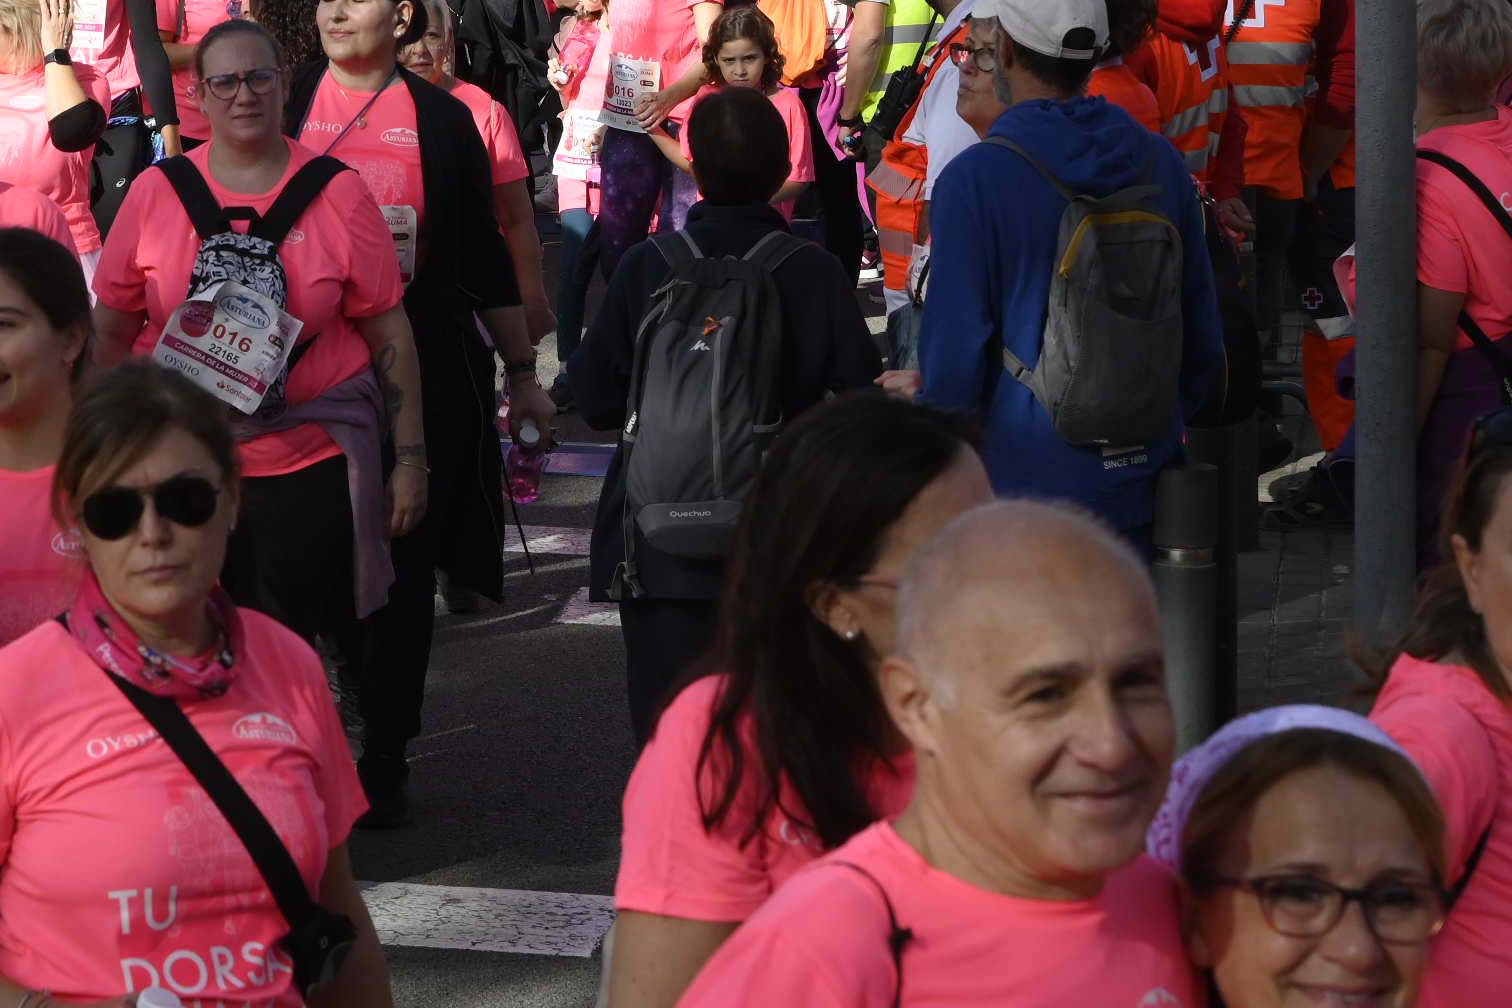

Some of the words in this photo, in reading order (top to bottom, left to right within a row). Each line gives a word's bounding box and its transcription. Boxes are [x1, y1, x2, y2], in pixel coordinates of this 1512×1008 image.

[615, 85, 634, 98] 016
[212, 324, 253, 353] 016
[208, 343, 240, 365] 22165
[108, 885, 180, 934] TU
